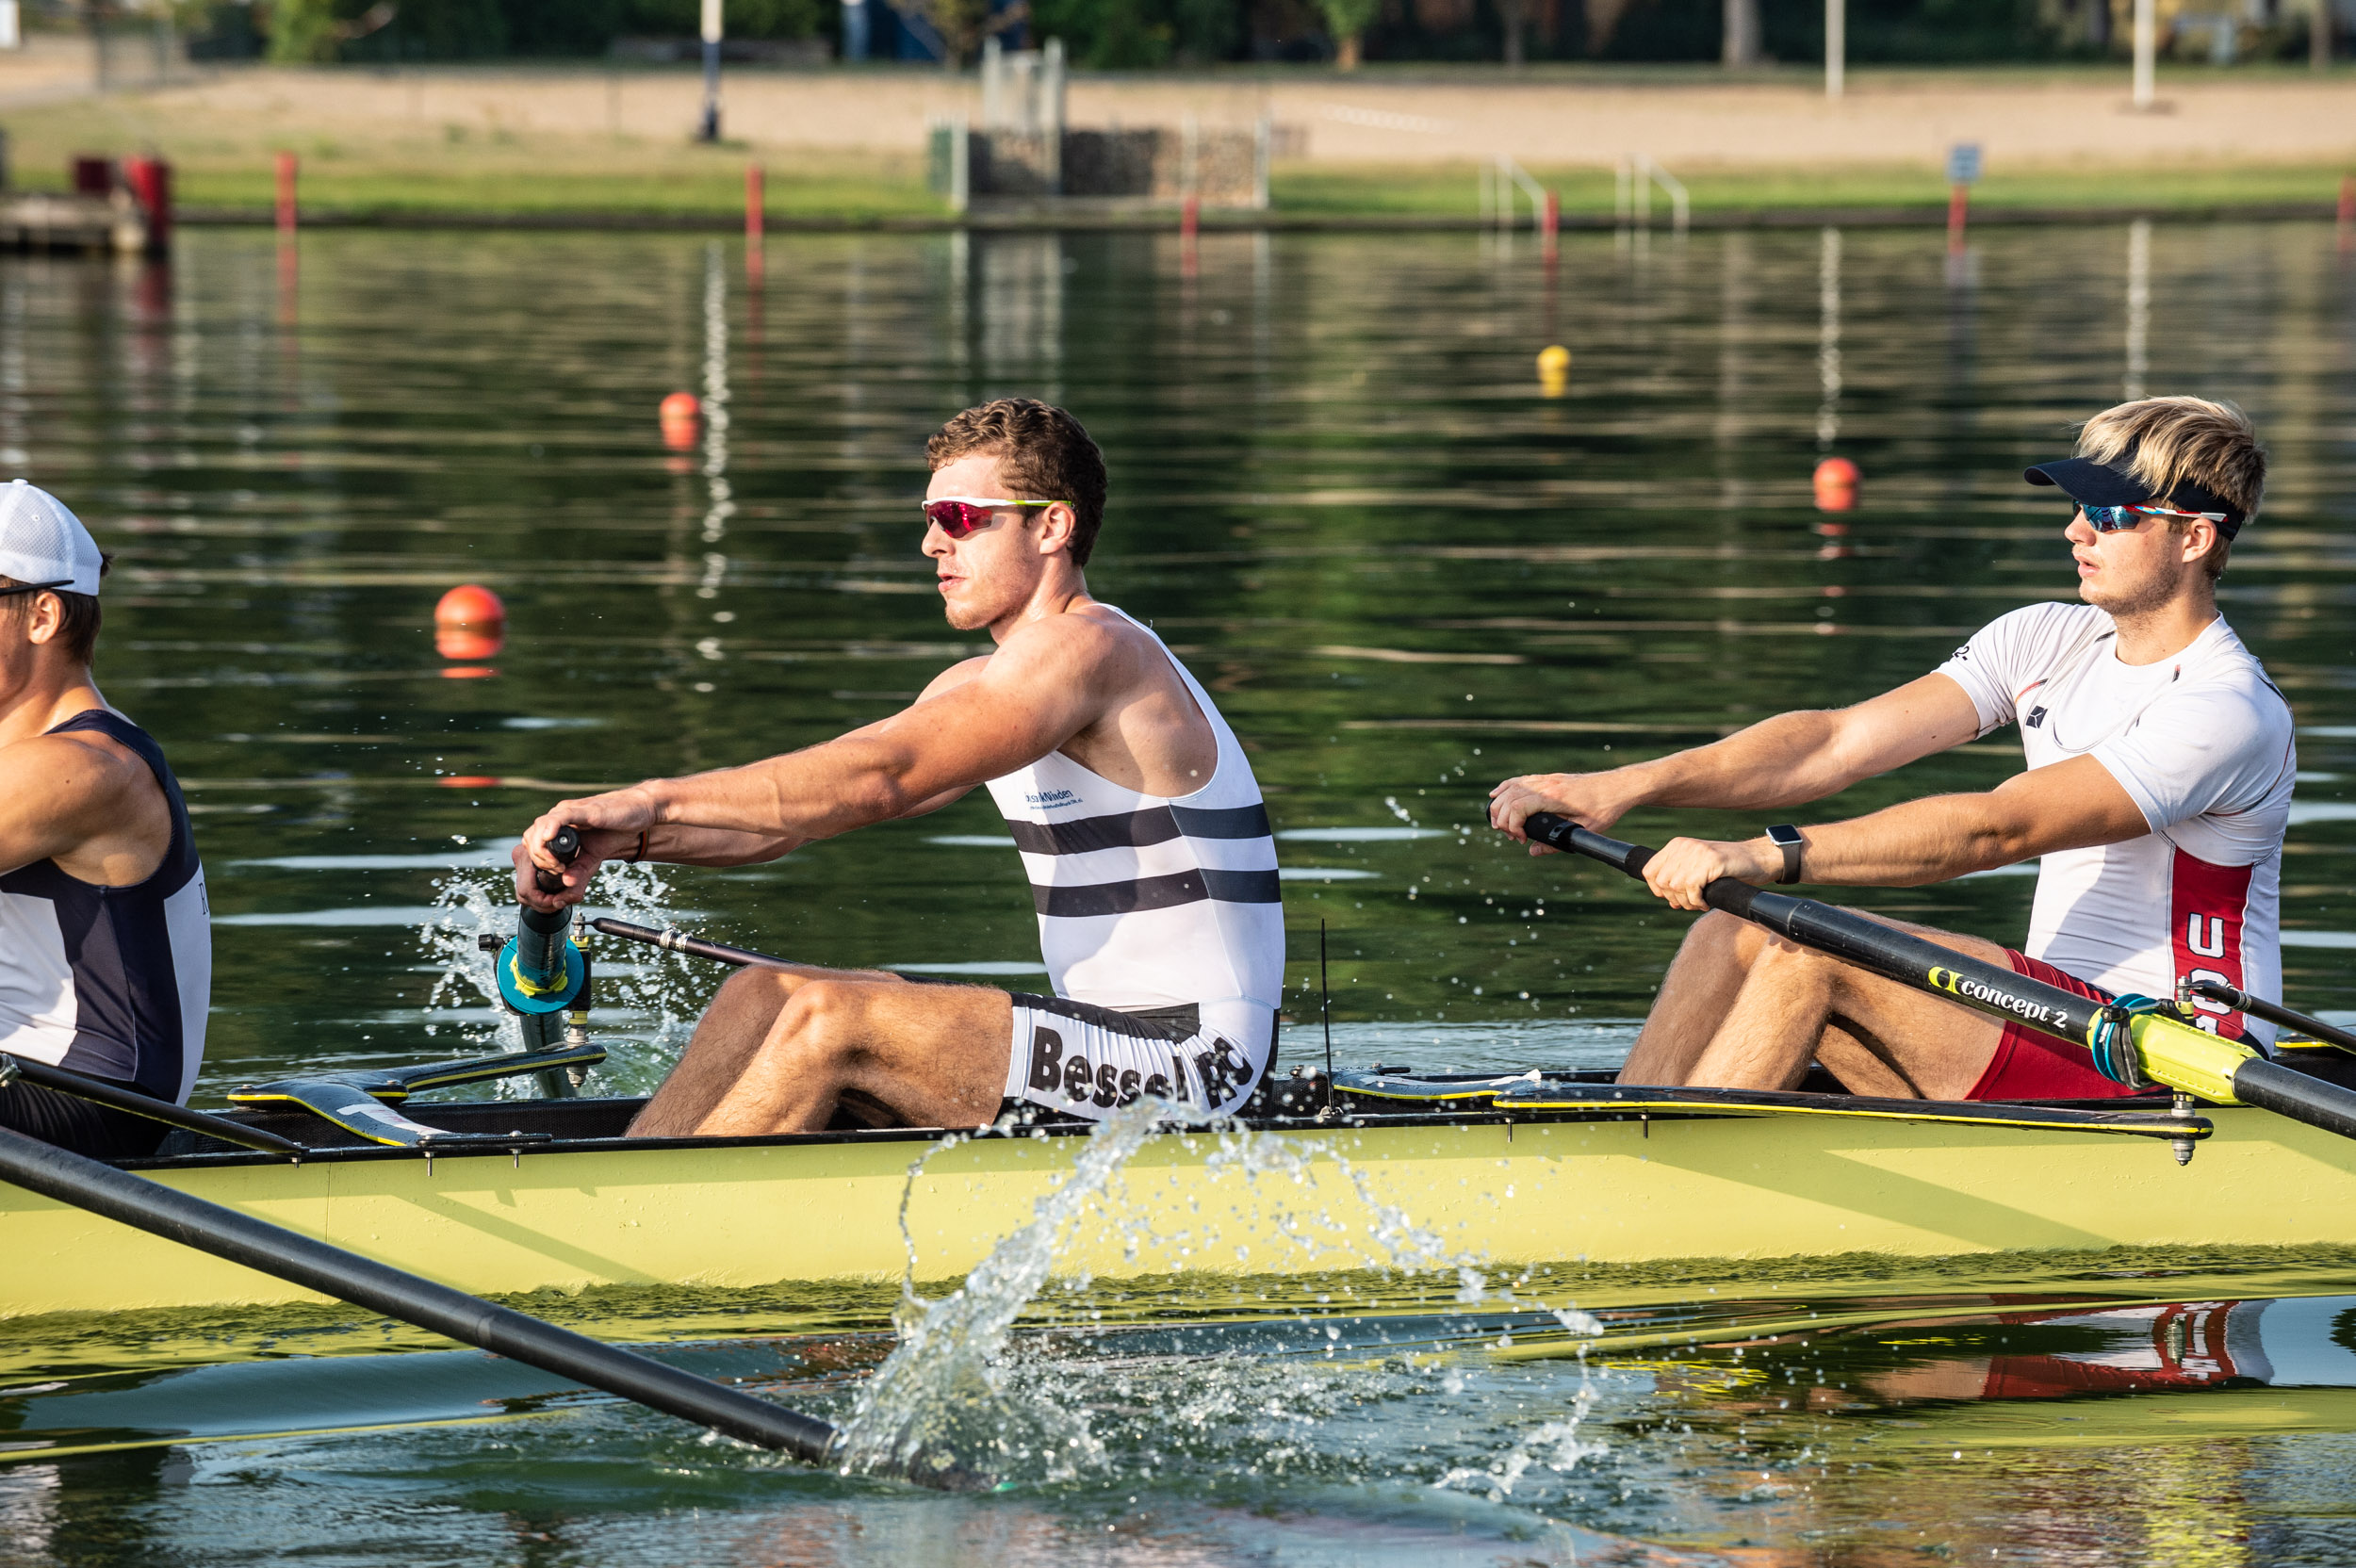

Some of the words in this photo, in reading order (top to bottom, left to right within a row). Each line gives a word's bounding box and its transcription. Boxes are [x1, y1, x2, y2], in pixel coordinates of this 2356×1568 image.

[1960, 980, 2050, 1021] concept
[2053, 1010, 2069, 1029] 2
[1028, 1025, 1189, 1109] Bessel
